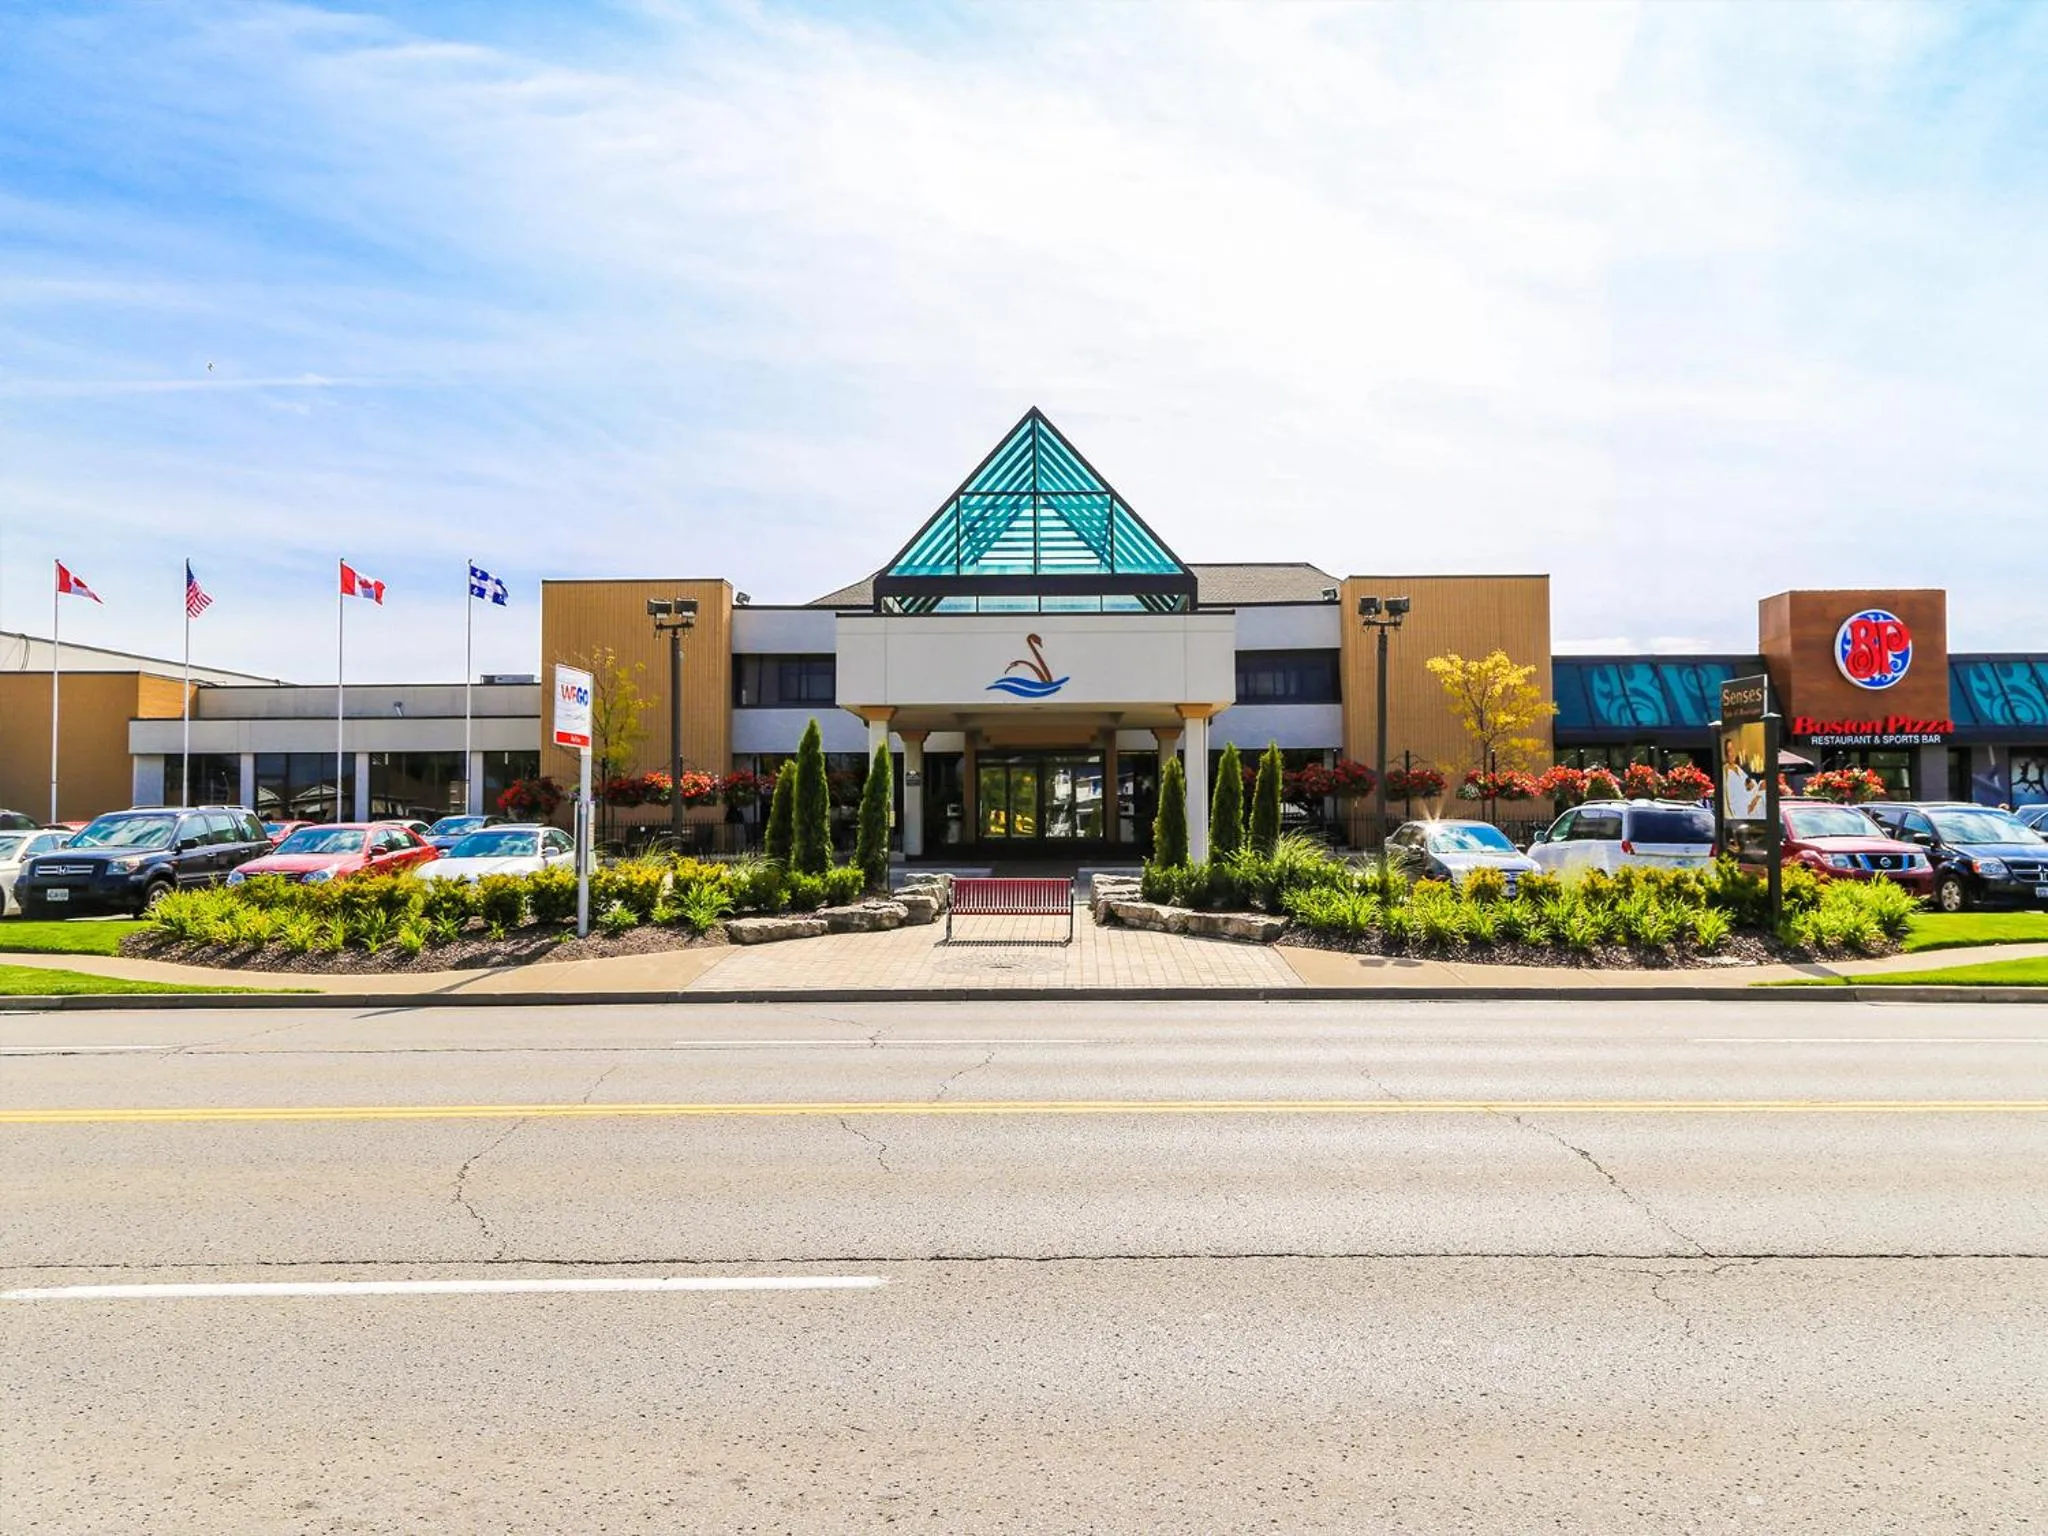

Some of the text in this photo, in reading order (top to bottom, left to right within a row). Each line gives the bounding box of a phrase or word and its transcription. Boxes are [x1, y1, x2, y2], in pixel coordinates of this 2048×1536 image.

[1723, 687, 1763, 707] Senses
[1792, 713, 1954, 735] Boston Pizza
[1811, 734, 1941, 745] RESTAURANT & SPORTS BAR
